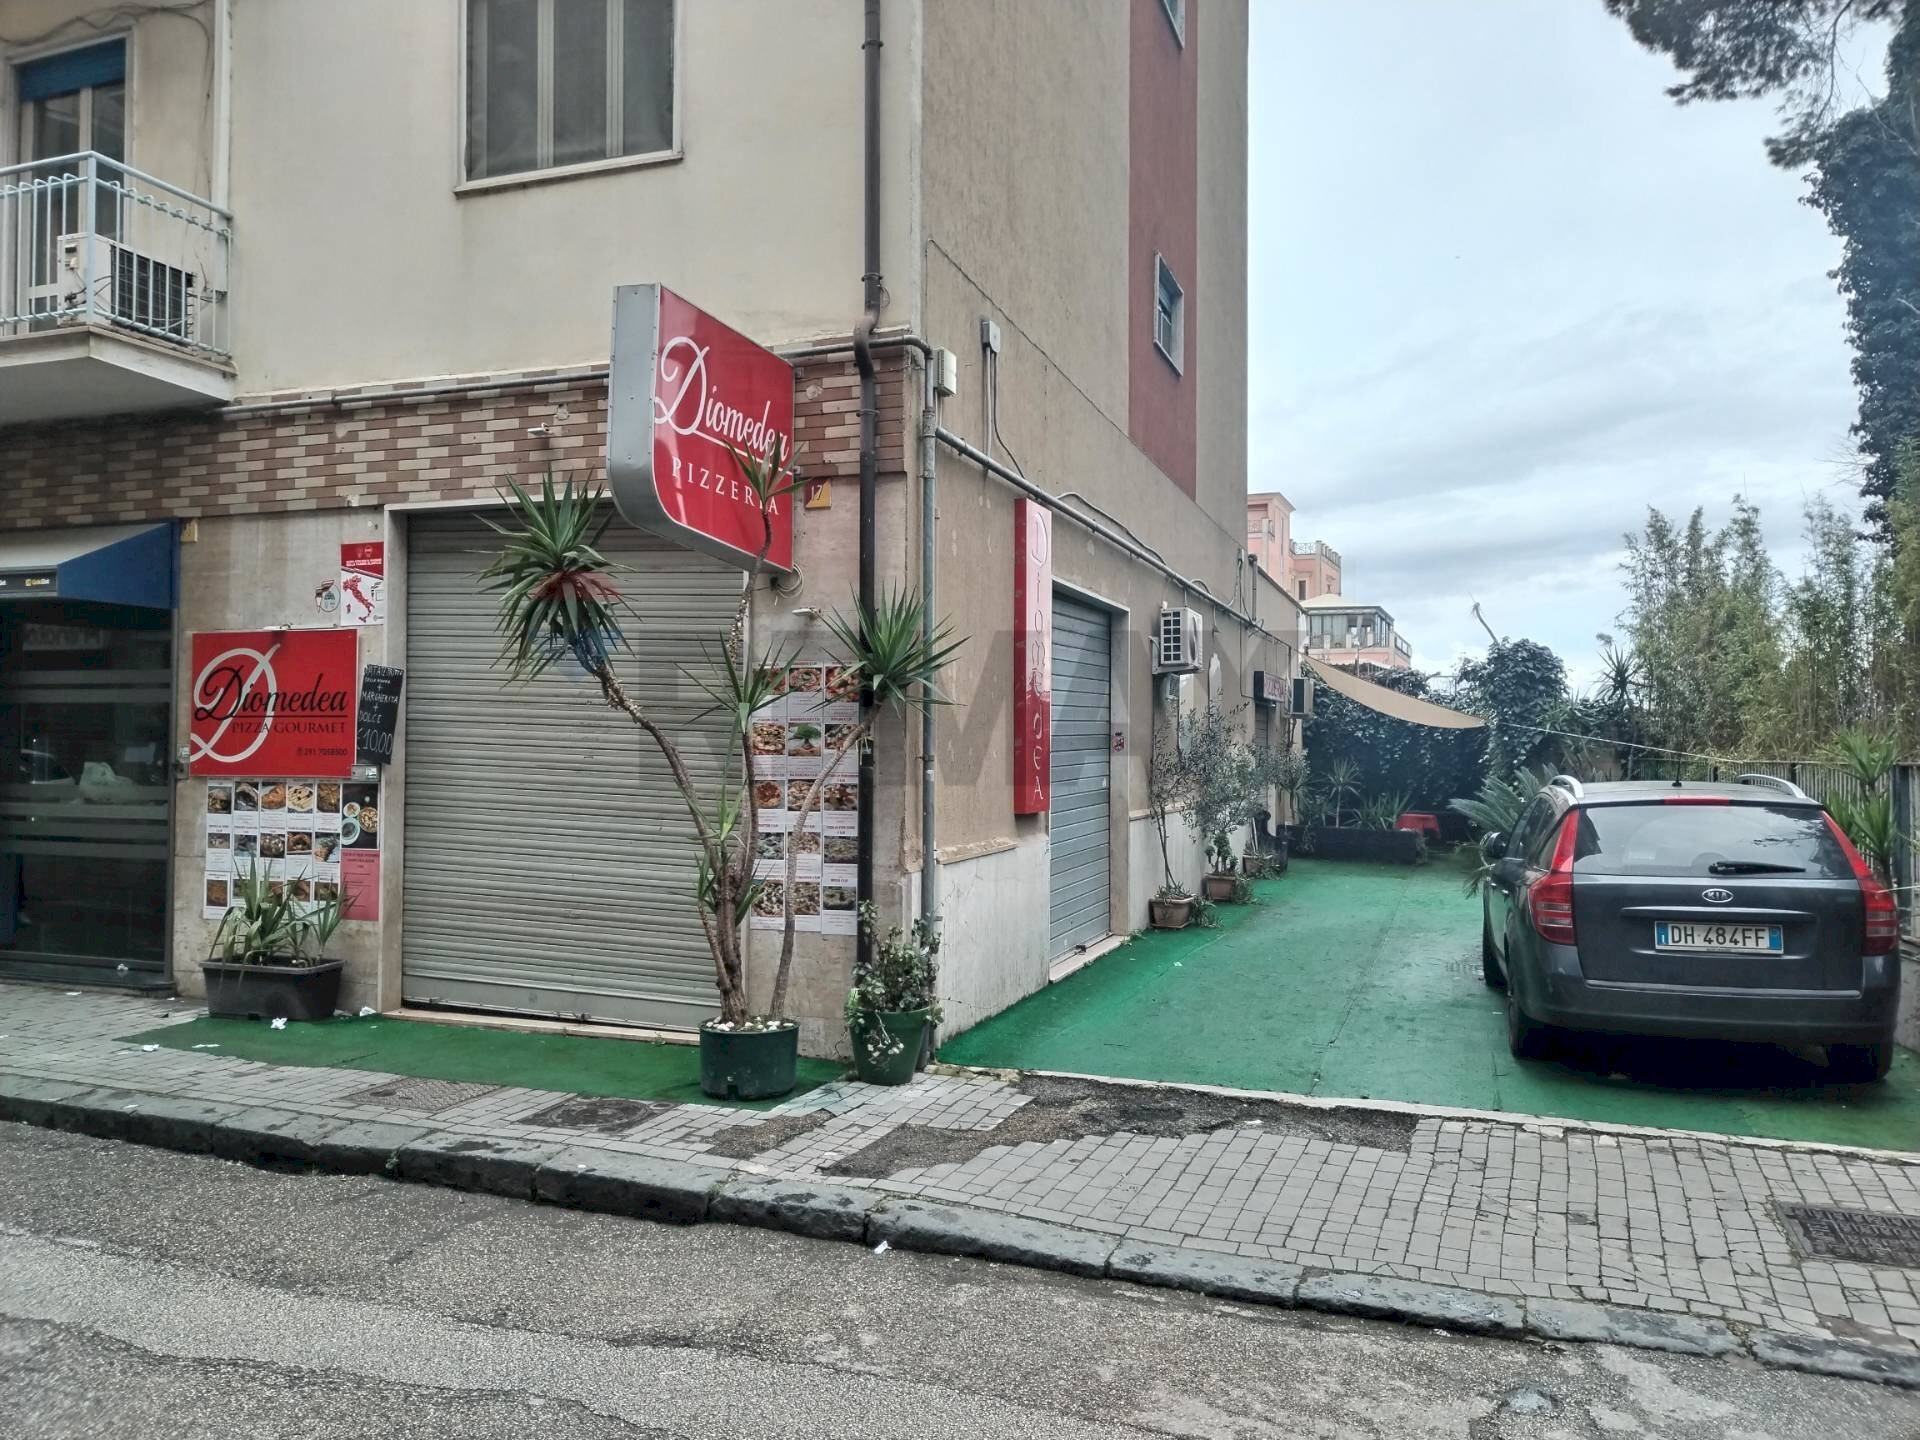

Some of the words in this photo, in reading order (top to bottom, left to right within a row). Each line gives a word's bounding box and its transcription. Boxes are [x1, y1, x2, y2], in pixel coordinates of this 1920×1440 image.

[811, 484, 824, 501] 17
[195, 666, 348, 720] Diomedea
[362, 691, 399, 704] MARGHERITA
[359, 711, 382, 723] DOLCE
[231, 720, 270, 734] PIZZA
[273, 721, 346, 734] GOURMET
[1707, 890, 1729, 901] KIA
[1671, 926, 1696, 945] DH
[1703, 927, 1766, 947] 484FF
